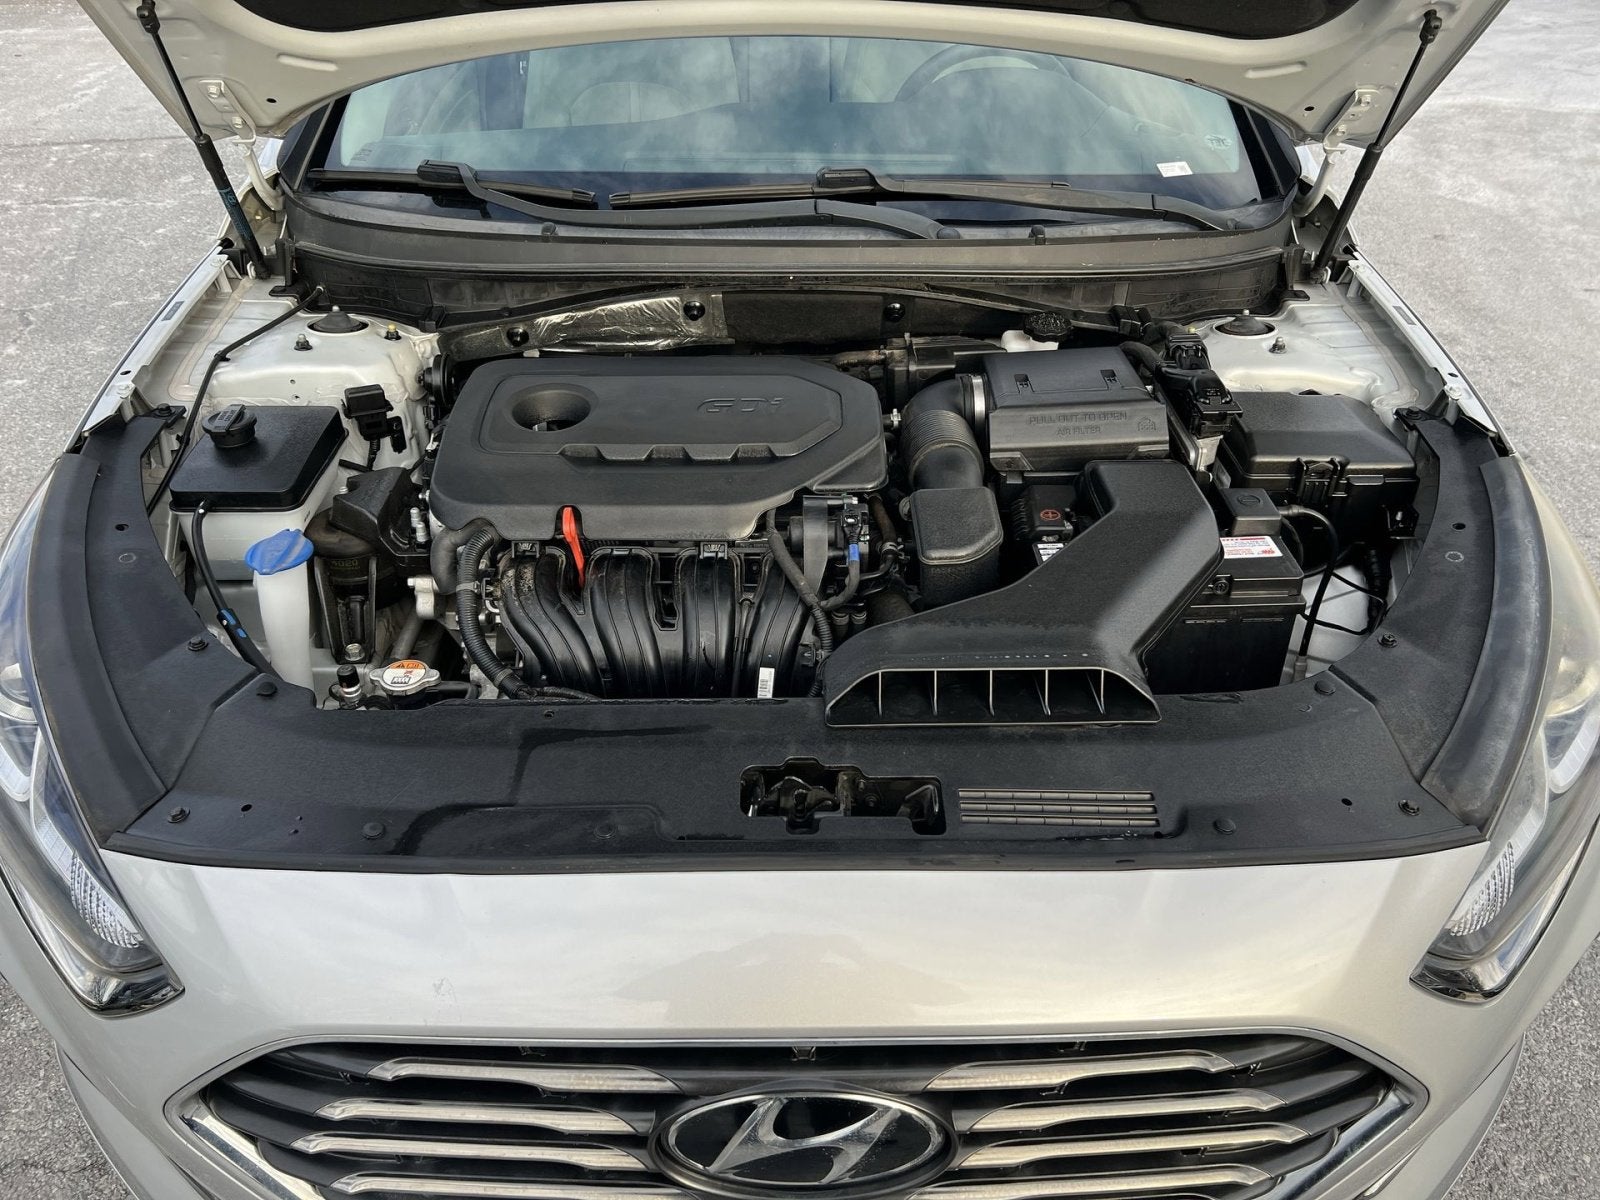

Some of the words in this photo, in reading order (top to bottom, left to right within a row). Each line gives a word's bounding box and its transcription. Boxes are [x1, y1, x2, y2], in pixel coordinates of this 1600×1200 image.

[1028, 415, 1056, 425] PULL
[1058, 414, 1080, 424] OUT
[1083, 413, 1097, 422] TO
[1098, 411, 1128, 421] OPEN
[1056, 426, 1071, 436] AIR
[1073, 425, 1102, 435] FILTER
